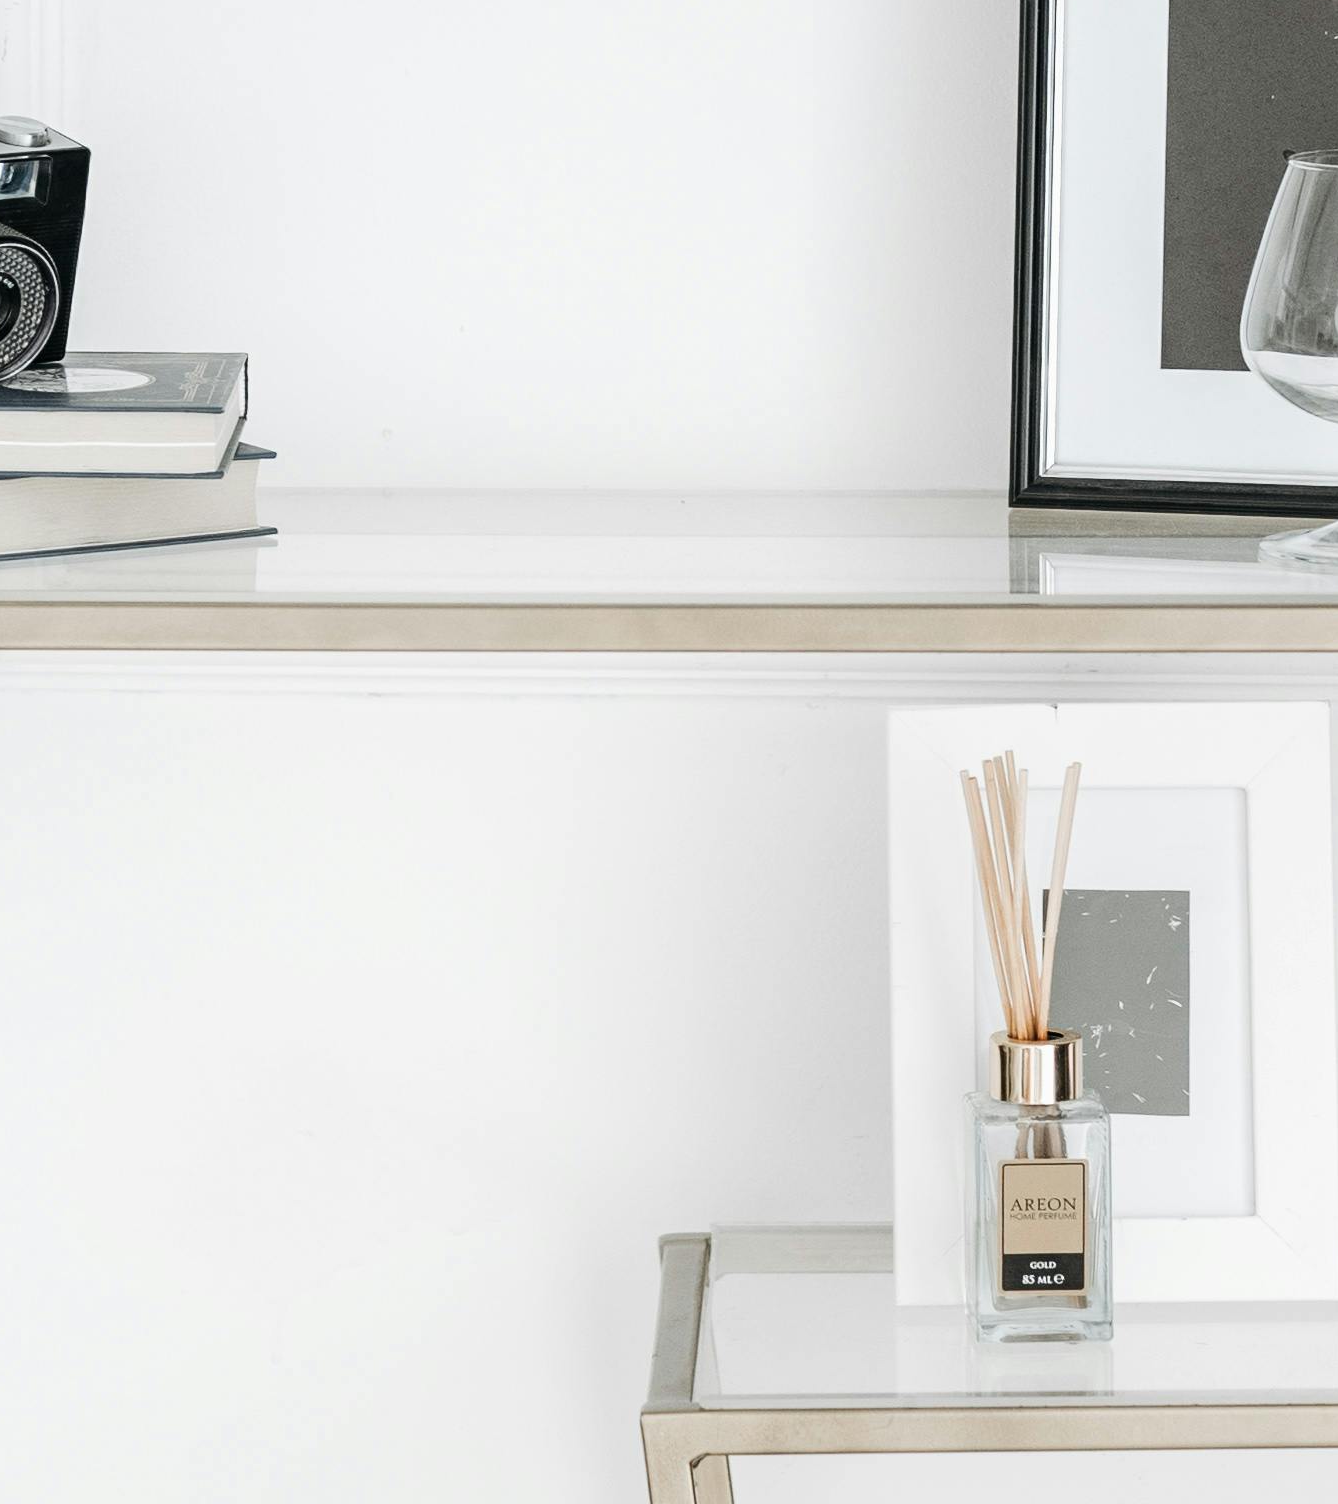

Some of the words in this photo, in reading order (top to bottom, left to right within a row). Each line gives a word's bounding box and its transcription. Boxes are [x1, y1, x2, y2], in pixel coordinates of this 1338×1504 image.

[1010, 1197, 1077, 1211] AREON
[1009, 1212, 1036, 1220] HOME
[1038, 1212, 1077, 1220] PERFUME
[1029, 1260, 1057, 1270] GOLD
[1021, 1274, 1035, 1285] 85
[1037, 1275, 1052, 1284] ML
